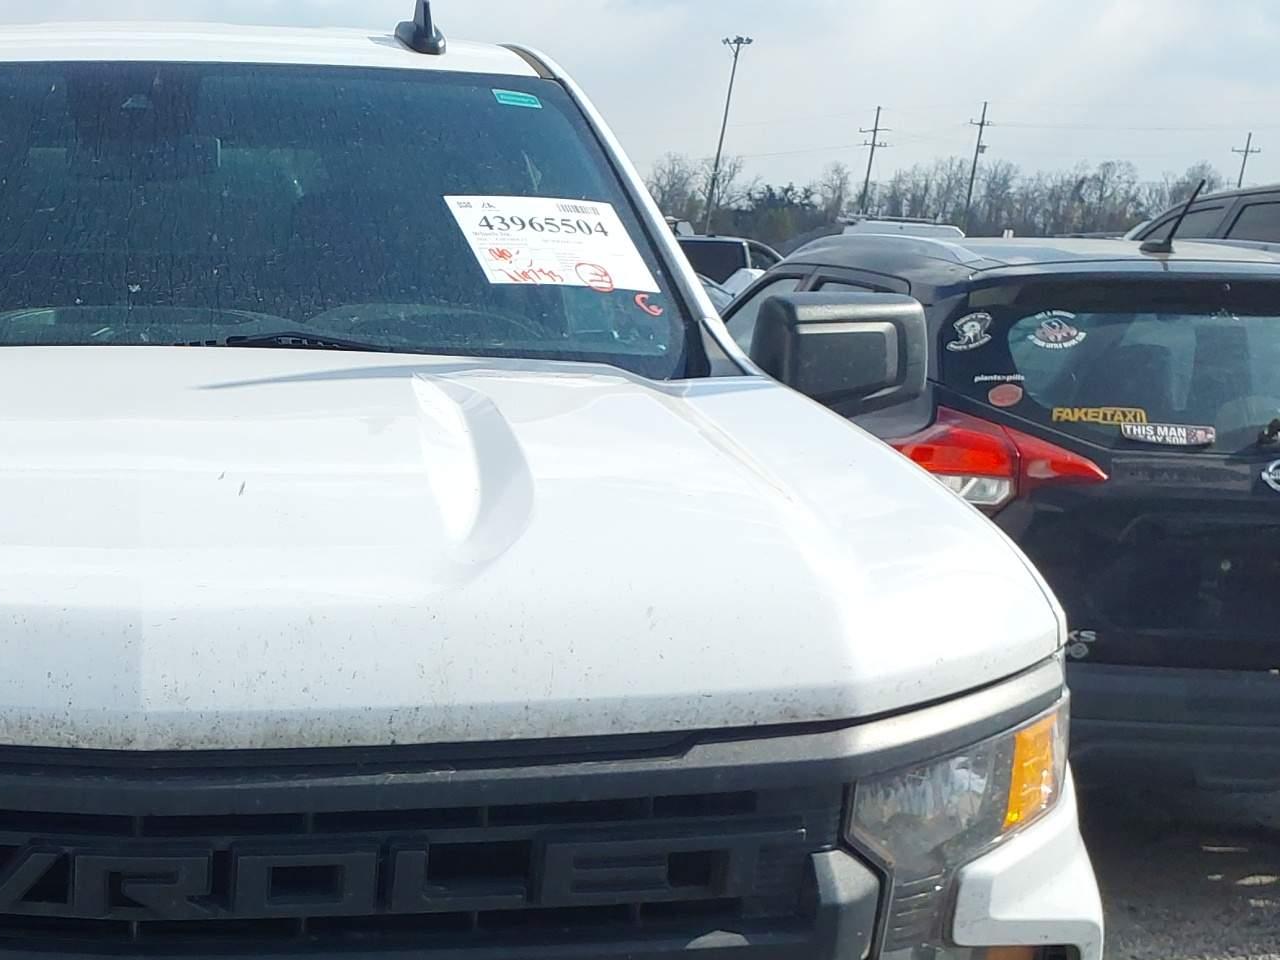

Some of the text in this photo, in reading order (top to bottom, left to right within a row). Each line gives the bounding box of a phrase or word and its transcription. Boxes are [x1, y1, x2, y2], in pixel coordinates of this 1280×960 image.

[477, 214, 609, 238] 43965504
[1124, 424, 1154, 436] THIS
[1156, 425, 1187, 438] MAN
